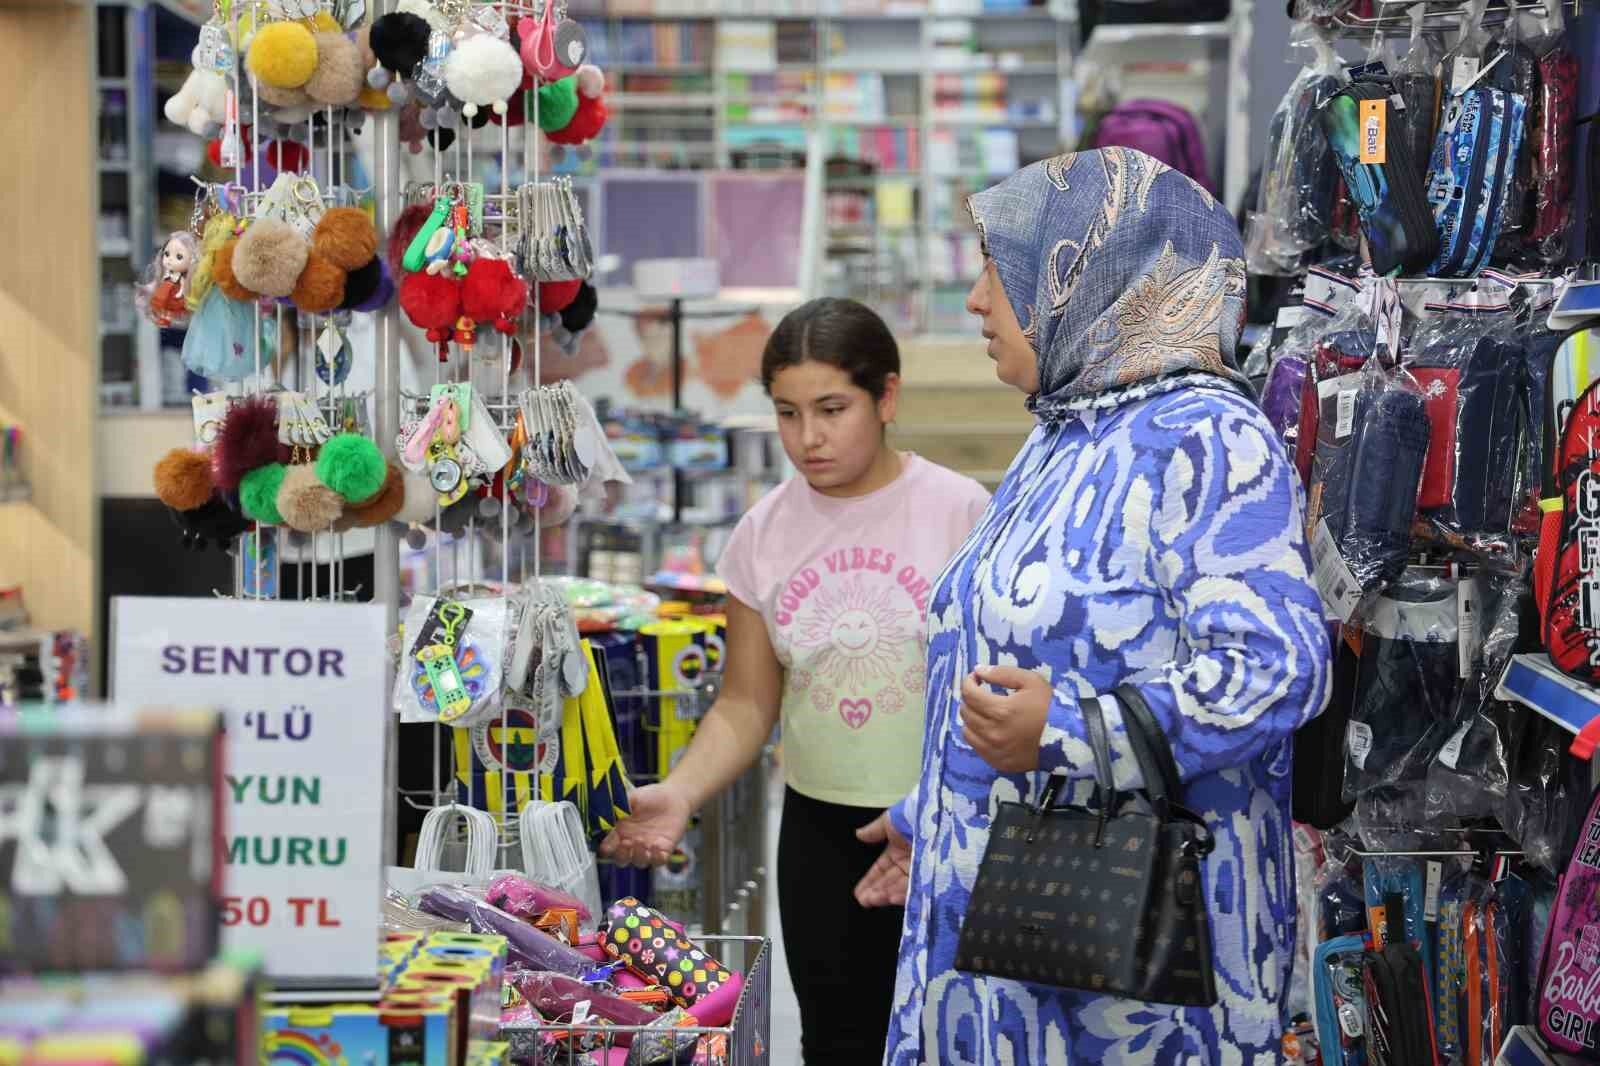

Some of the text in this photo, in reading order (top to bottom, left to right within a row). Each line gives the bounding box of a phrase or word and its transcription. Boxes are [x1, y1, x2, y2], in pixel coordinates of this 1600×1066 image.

[824, 547, 896, 574] VIBES
[161, 645, 345, 677] SENTOR
[287, 898, 341, 927] TL
[1548, 1005, 1595, 1048] GIRL
